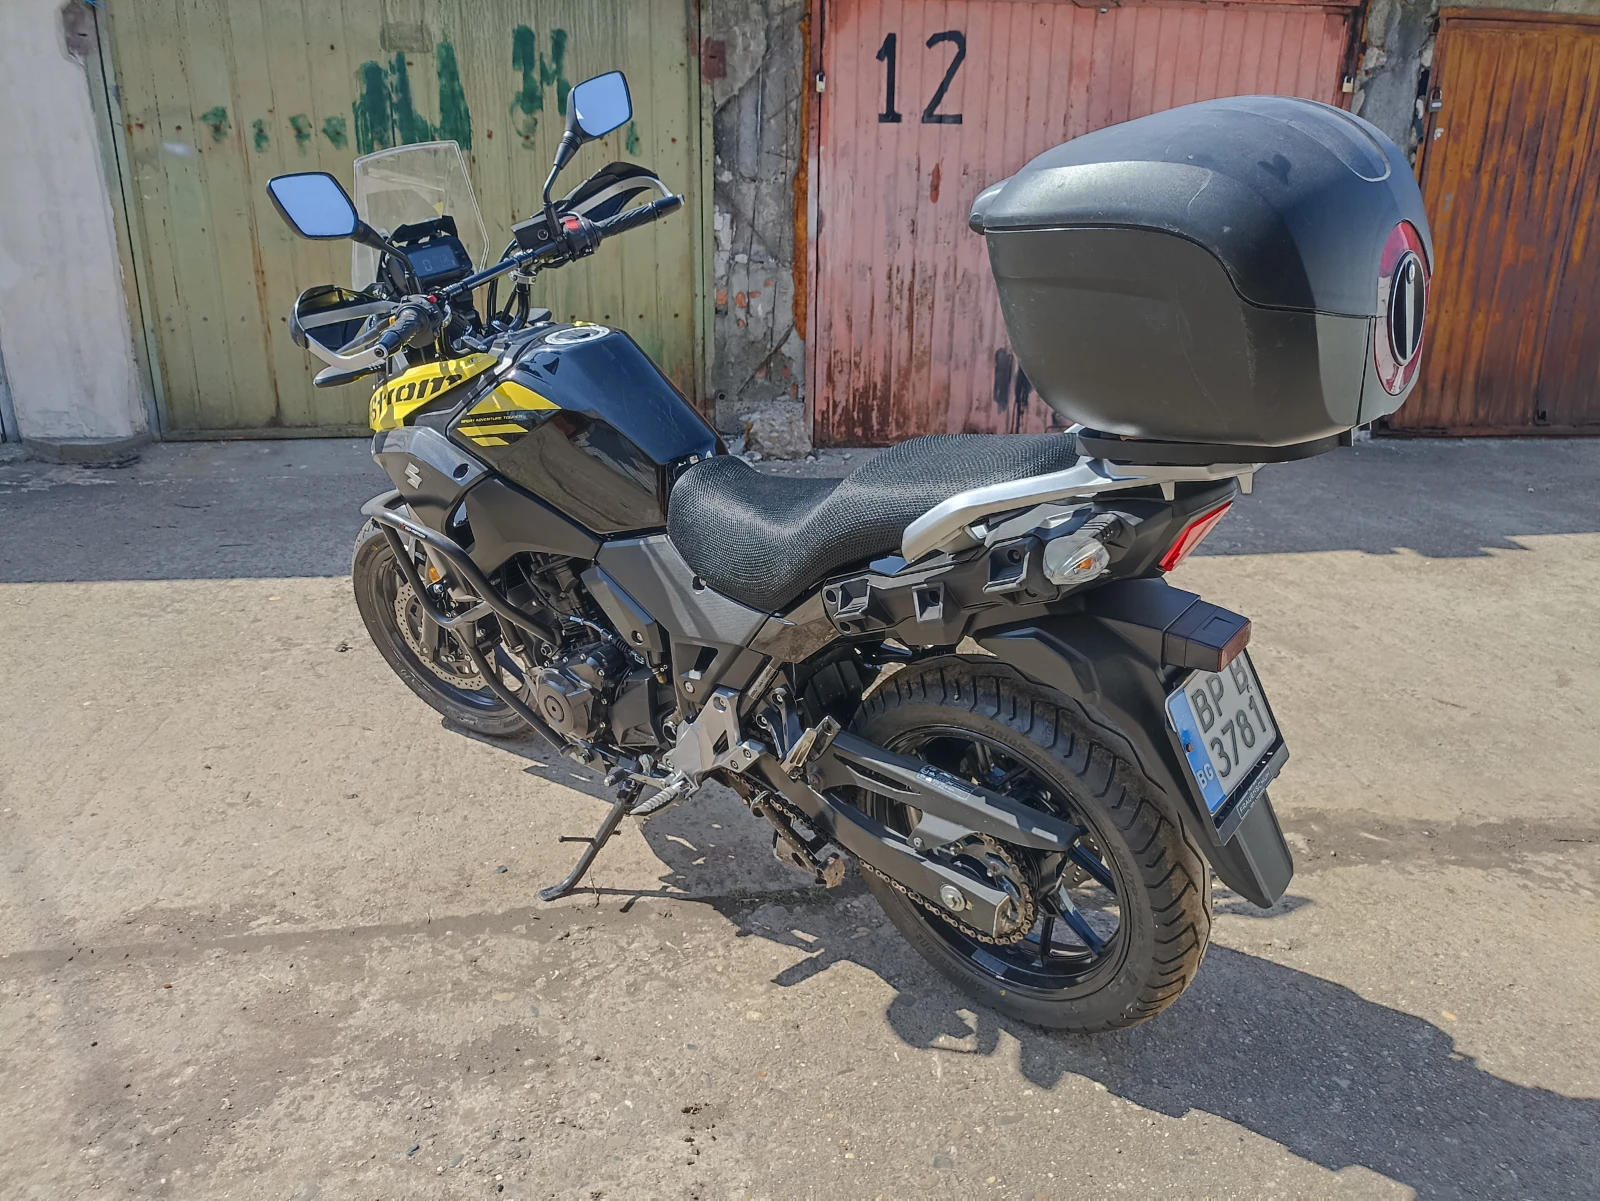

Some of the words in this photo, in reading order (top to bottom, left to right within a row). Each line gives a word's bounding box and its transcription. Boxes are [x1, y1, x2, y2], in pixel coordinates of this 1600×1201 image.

[876, 30, 966, 124] 12
[1191, 673, 1224, 733] BP
[1229, 657, 1248, 695] B
[1210, 695, 1266, 777] 3781
[1196, 762, 1214, 790] BG
